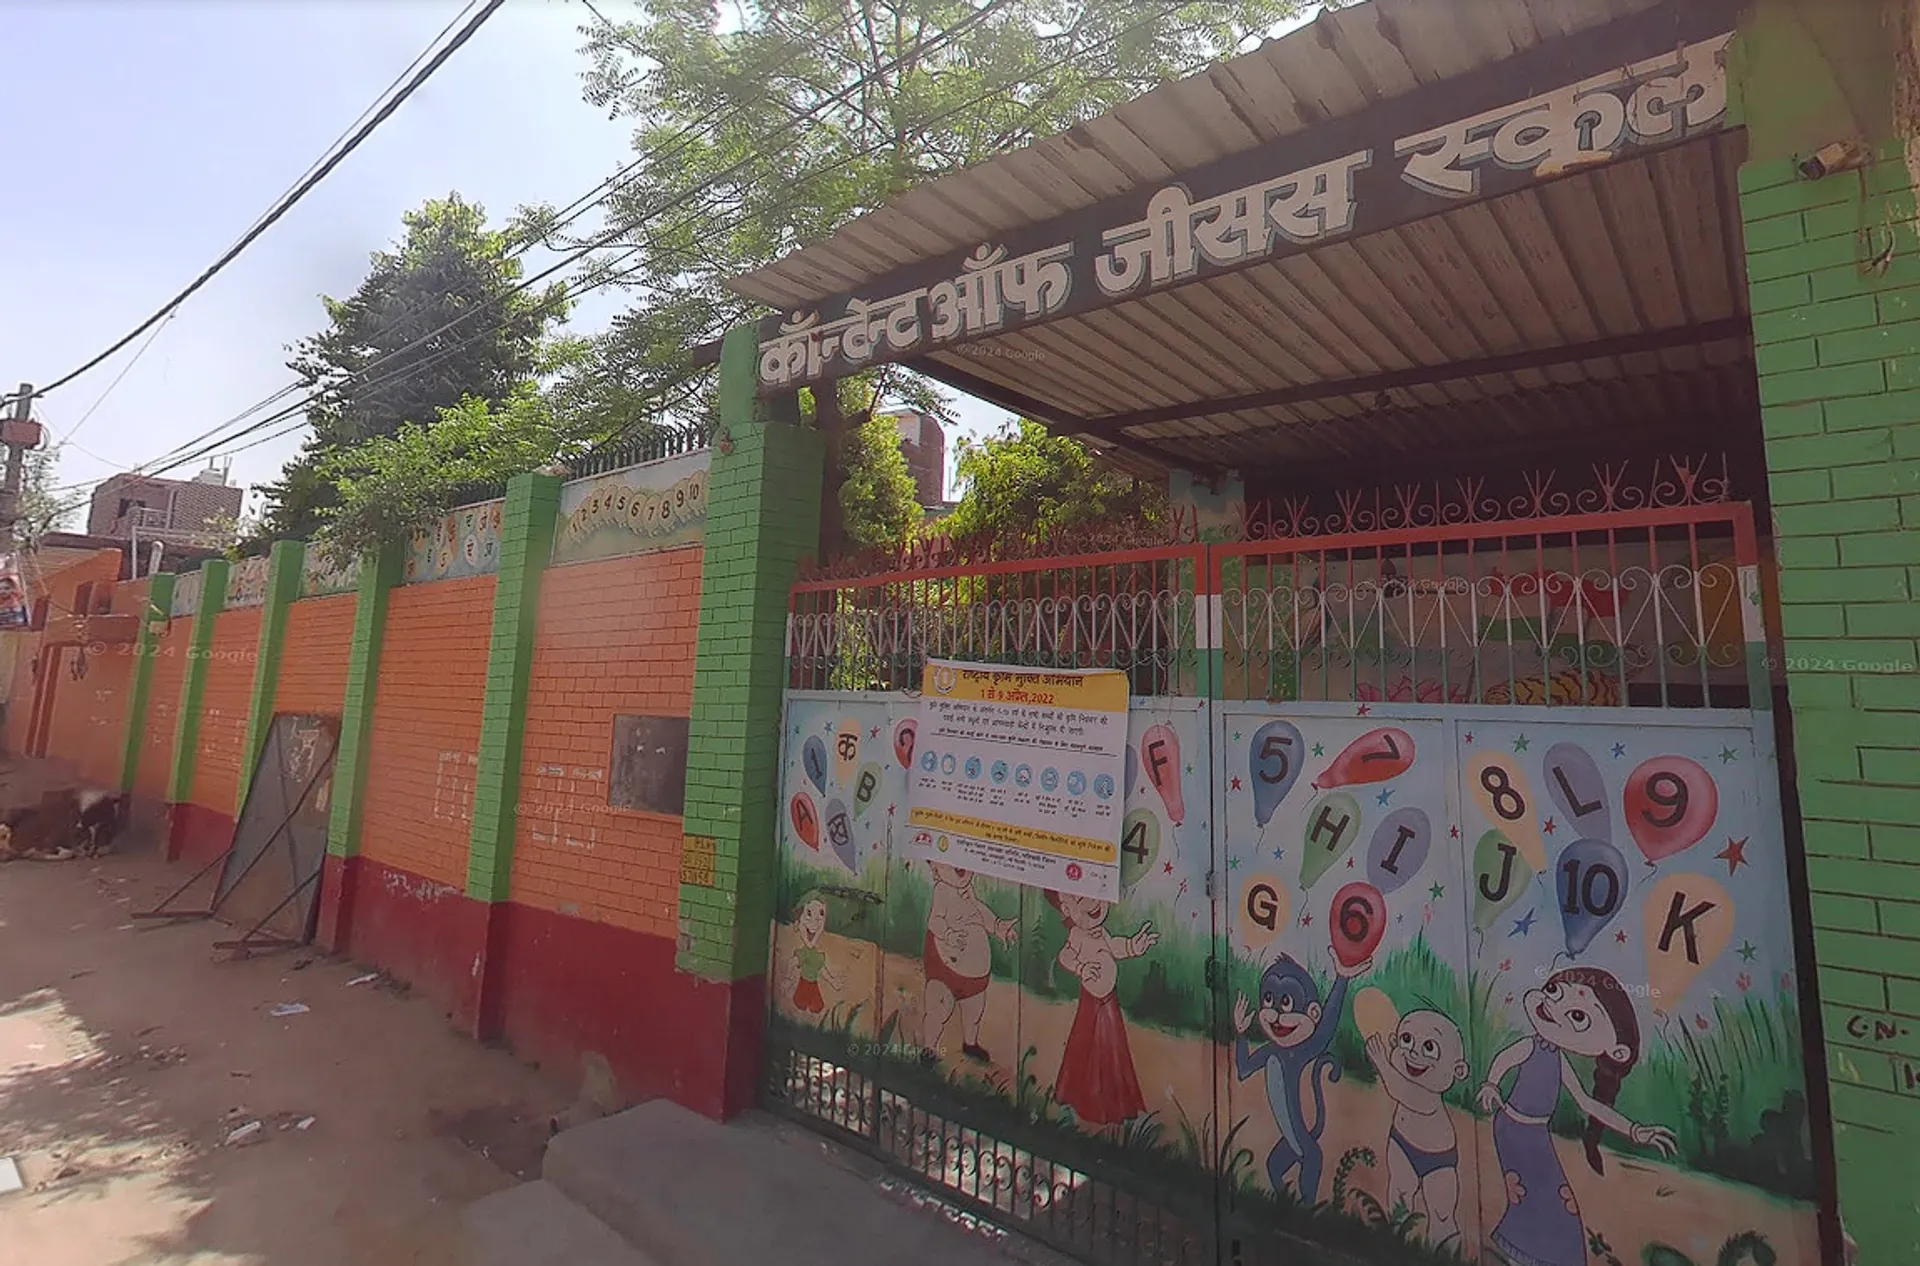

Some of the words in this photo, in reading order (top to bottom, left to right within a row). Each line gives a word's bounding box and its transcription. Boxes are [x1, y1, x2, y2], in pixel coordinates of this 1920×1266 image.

[928, 241, 1075, 342] ऑफ
[1095, 150, 1374, 298] जीसस
[581, 509, 588, 521] 2
[592, 499, 599, 514] 3
[604, 494, 612, 510] 4
[617, 496, 626, 510] 5
[631, 501, 640, 517] 6
[648, 506, 655, 520] 7
[661, 500, 671, 518] 8
[676, 489, 684, 508] 9
[689, 483, 699, 500] 10
[838, 733, 858, 761] क
[1148, 739, 1168, 786] F
[1258, 736, 1293, 784] 5
[1360, 734, 1400, 762] 7
[856, 771, 876, 802] B
[1480, 765, 1526, 820] 8
[1552, 766, 1603, 818] L
[1642, 771, 1690, 828] 9
[796, 799, 814, 831] A
[1310, 806, 1350, 851] H
[1121, 821, 1149, 865] 4
[1380, 824, 1415, 875] I
[1478, 843, 1517, 901] J
[1562, 858, 1620, 917] 10
[1247, 883, 1279, 931] G
[1339, 895, 1374, 943] 6
[1657, 891, 1717, 965] K
